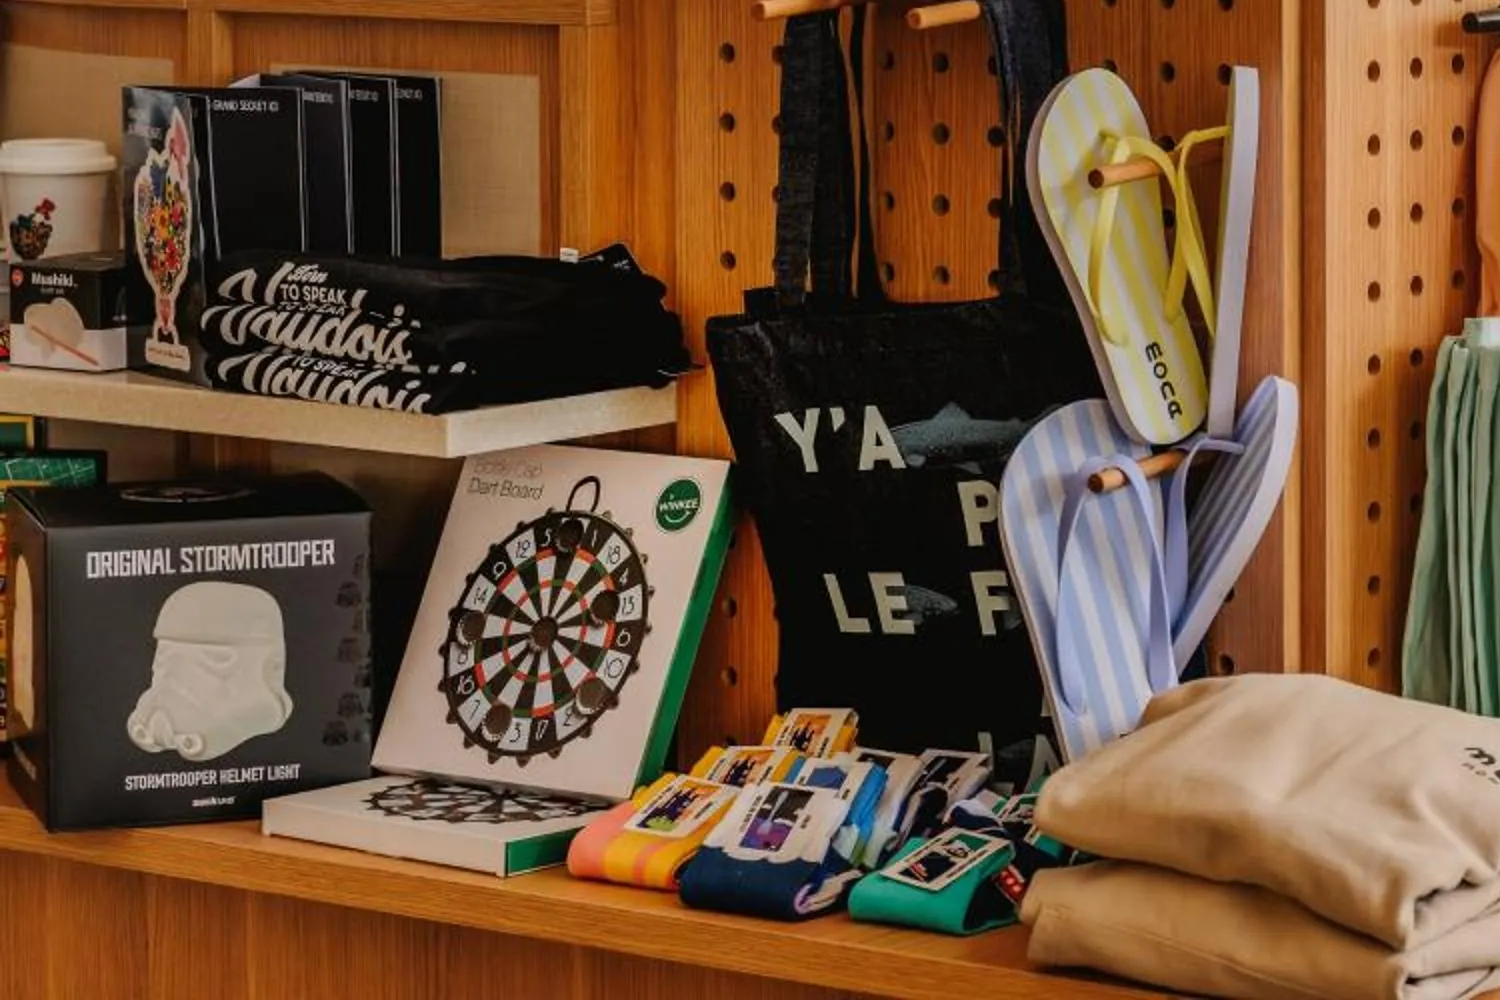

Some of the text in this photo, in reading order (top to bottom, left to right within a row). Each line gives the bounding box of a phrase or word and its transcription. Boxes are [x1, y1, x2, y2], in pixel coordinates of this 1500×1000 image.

[280, 283, 300, 300] TO
[302, 286, 348, 305] SPEAK
[467, 476, 544, 501] Dart Board
[86, 539, 336, 579] ORIGINAL STORMTROOPER
[824, 571, 916, 634] LE
[616, 630, 631, 648] 6
[455, 675, 475, 695] 16
[125, 763, 302, 791] STORMTROOPER HELMET LIGHT
